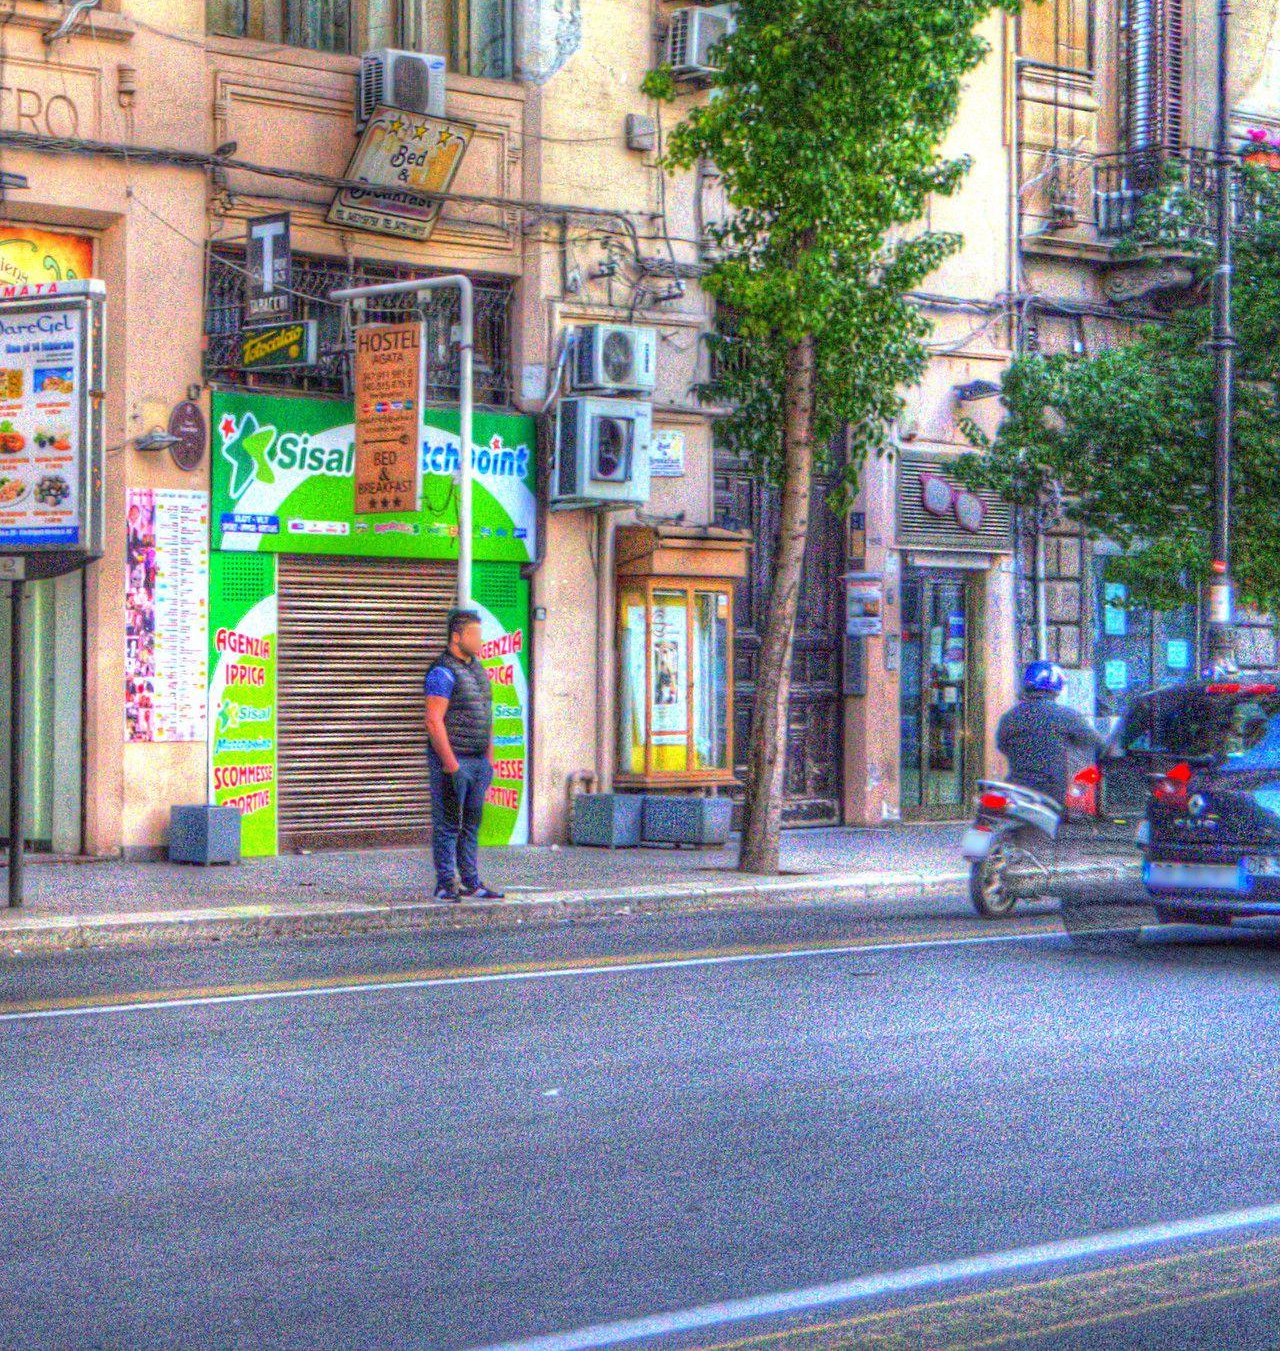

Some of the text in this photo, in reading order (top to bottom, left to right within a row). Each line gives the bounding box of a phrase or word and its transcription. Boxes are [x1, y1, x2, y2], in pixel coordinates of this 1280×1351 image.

[391, 144, 428, 168] Bed
[252, 221, 285, 292] T
[358, 331, 419, 352] HOSTEL
[277, 436, 530, 476] Sisal tchoint
[374, 452, 397, 466] BED
[358, 480, 412, 494] BREAKFAST
[216, 629, 271, 658] AGENZIA
[225, 664, 265, 686] IPPICA
[486, 664, 514, 686] PICA
[239, 706, 271, 721] Sisal
[495, 705, 522, 717] Sisal
[214, 765, 273, 790] SCOMMESSE
[493, 759, 524, 780] MESSE
[485, 787, 518, 810] RTIVE
